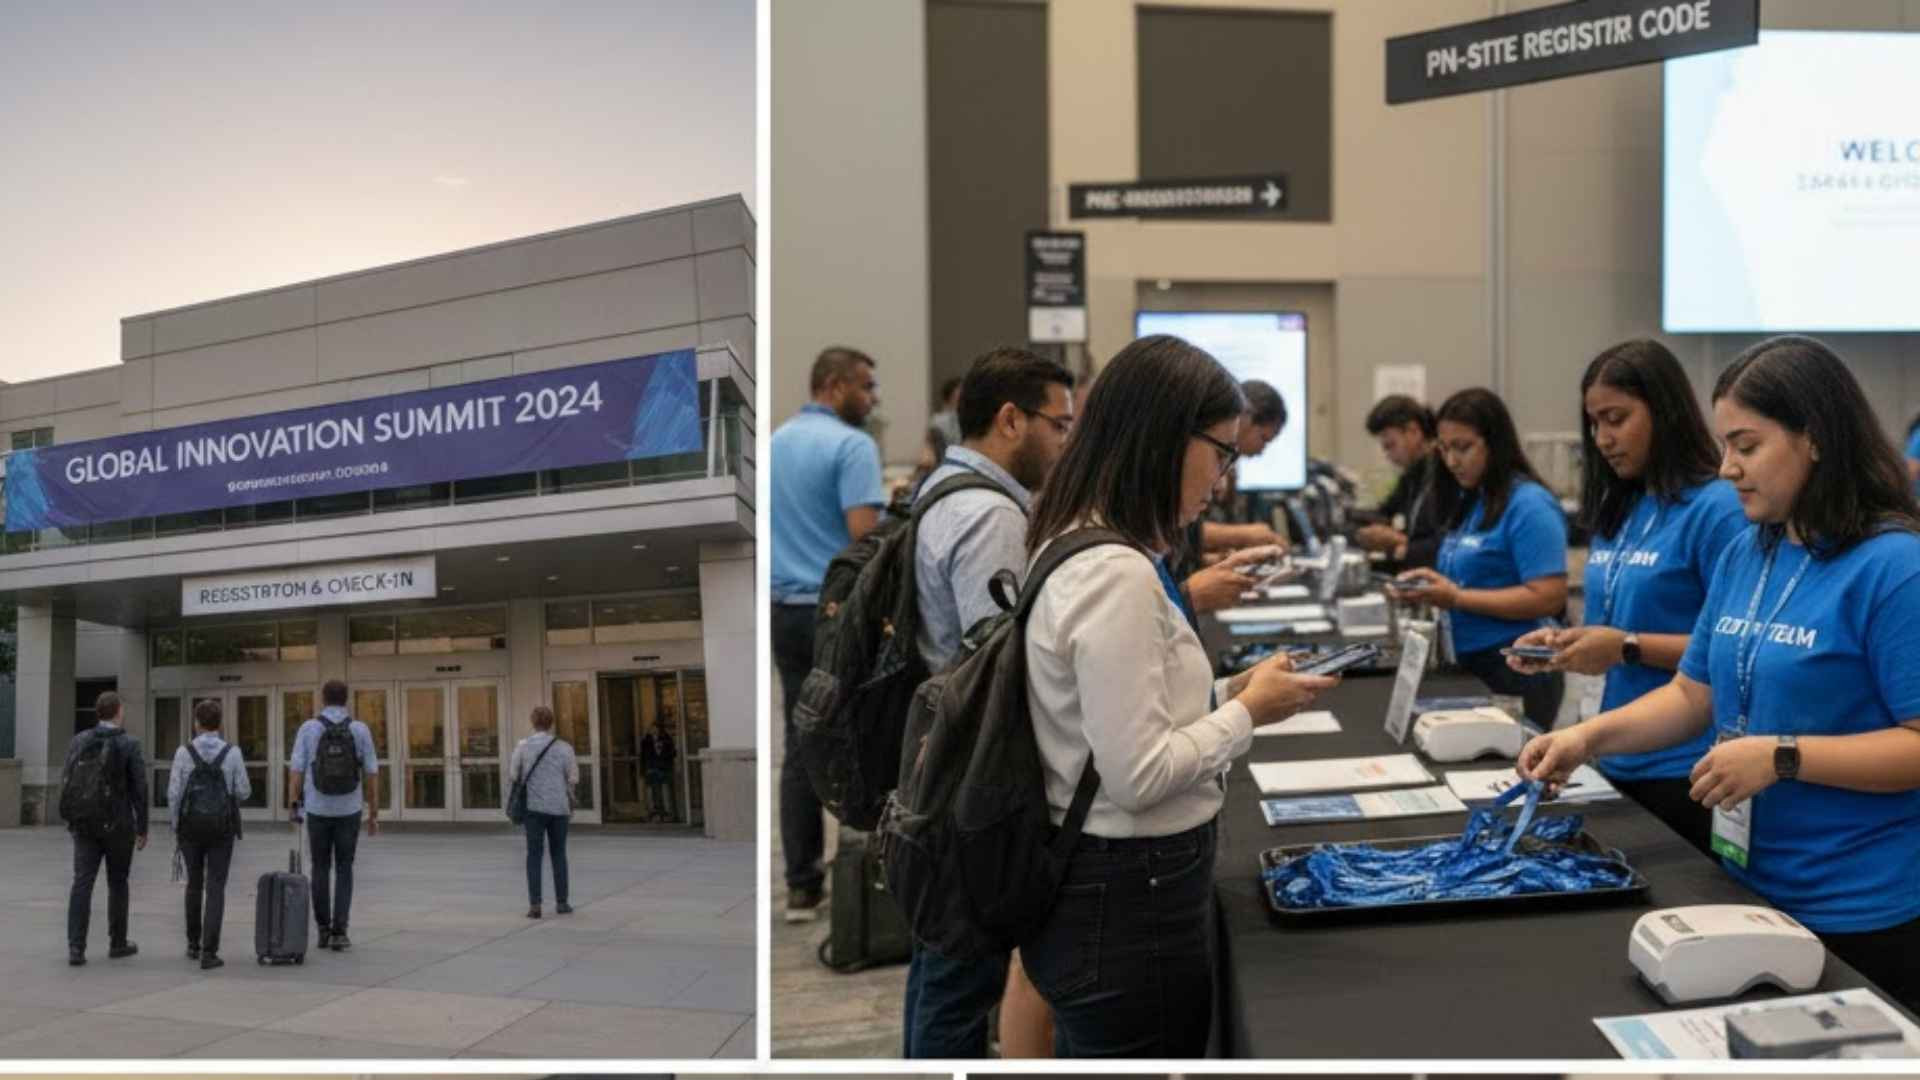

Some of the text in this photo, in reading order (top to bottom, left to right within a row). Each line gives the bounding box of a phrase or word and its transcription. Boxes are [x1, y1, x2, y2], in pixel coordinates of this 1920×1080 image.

[1639, 0, 1711, 40] CODE
[65, 380, 603, 484] GLOBAL INNOVATION SUMMIT 2024
